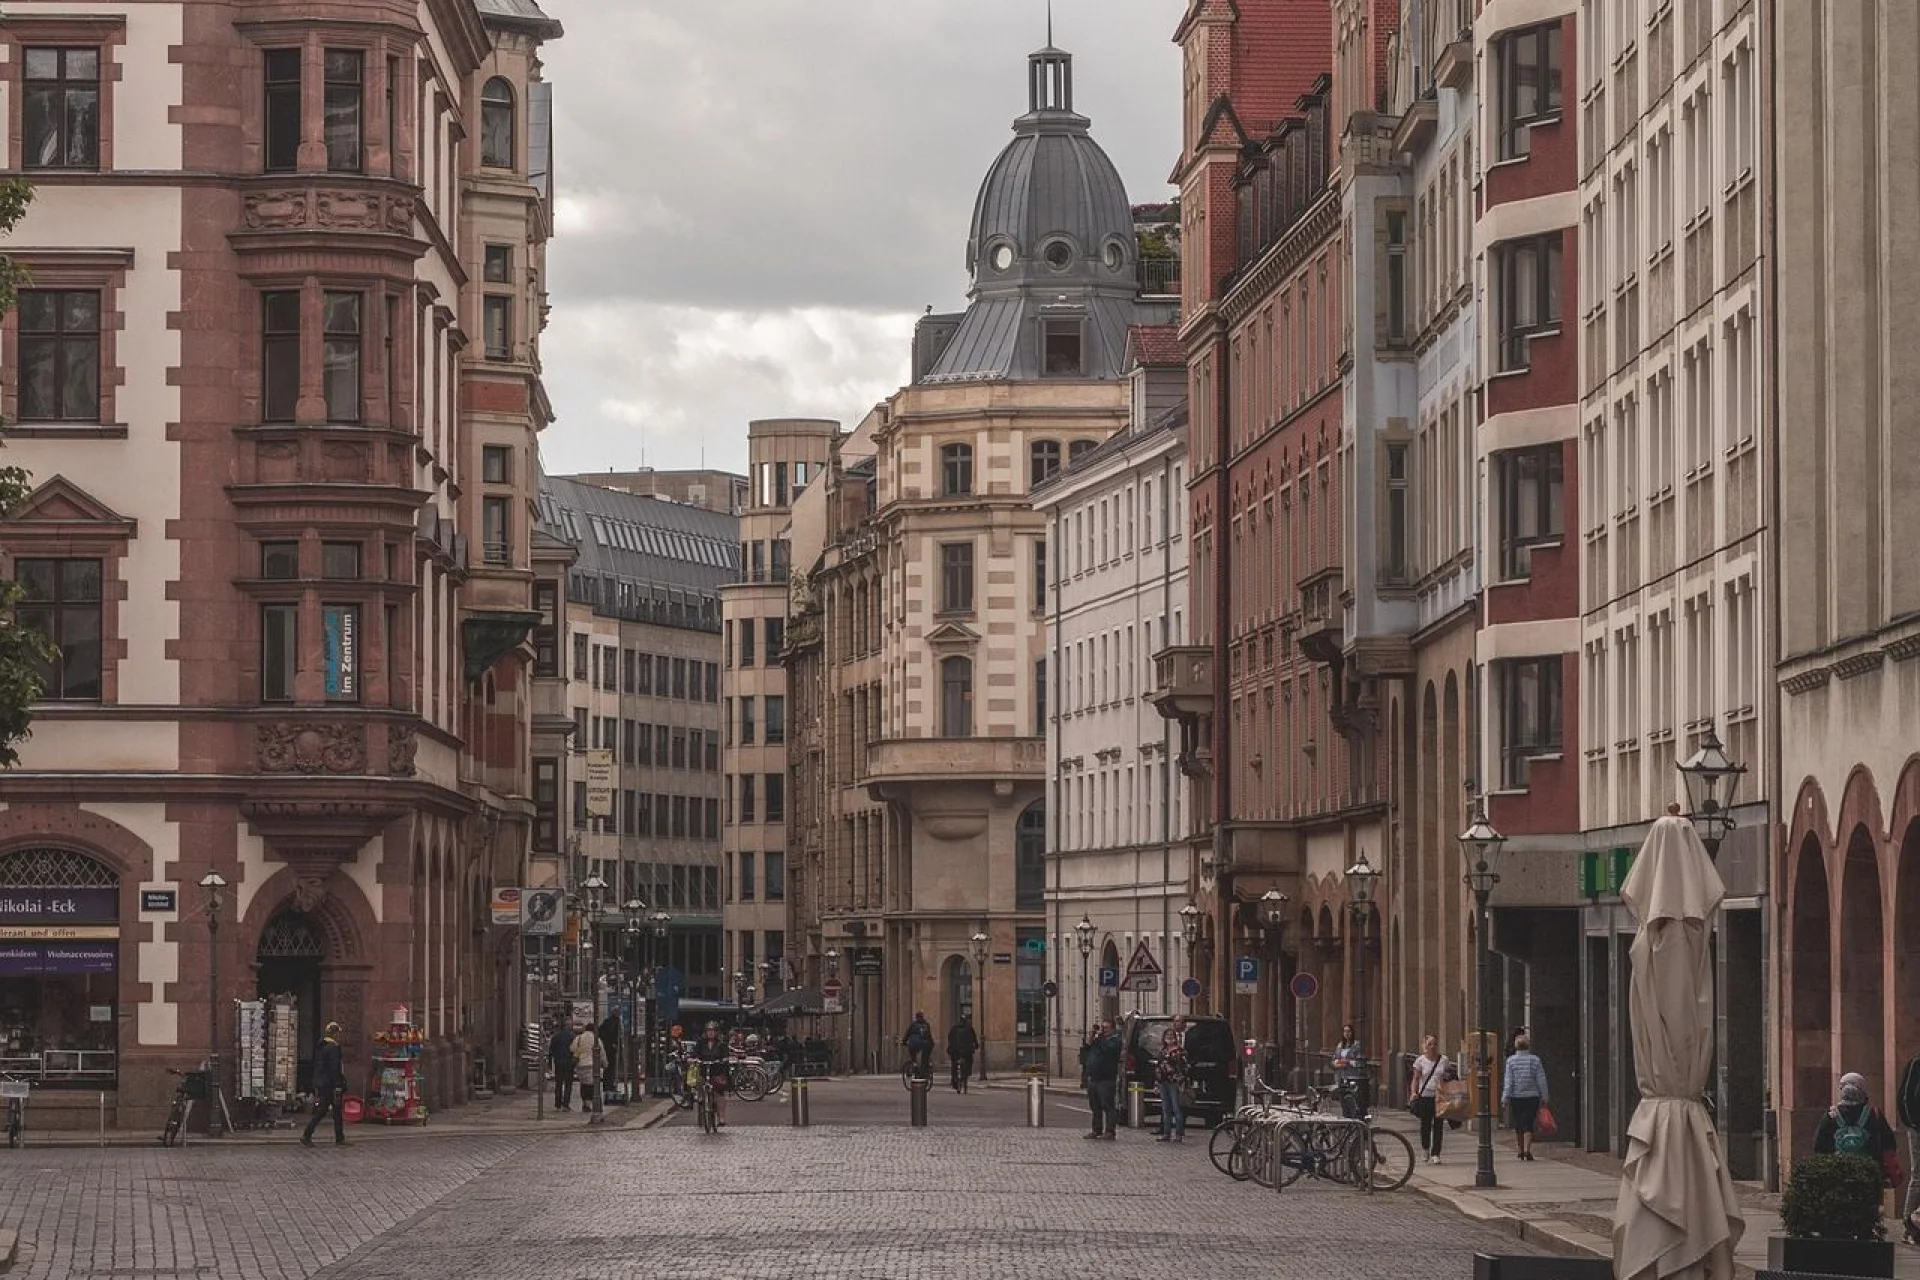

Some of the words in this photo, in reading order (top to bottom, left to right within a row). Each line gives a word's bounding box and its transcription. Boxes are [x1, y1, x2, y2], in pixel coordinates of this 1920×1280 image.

[341, 614, 352, 672] Zentrum
[341, 676, 352, 693] im
[1104, 970, 1114, 985] P
[1240, 961, 1254, 979] P
